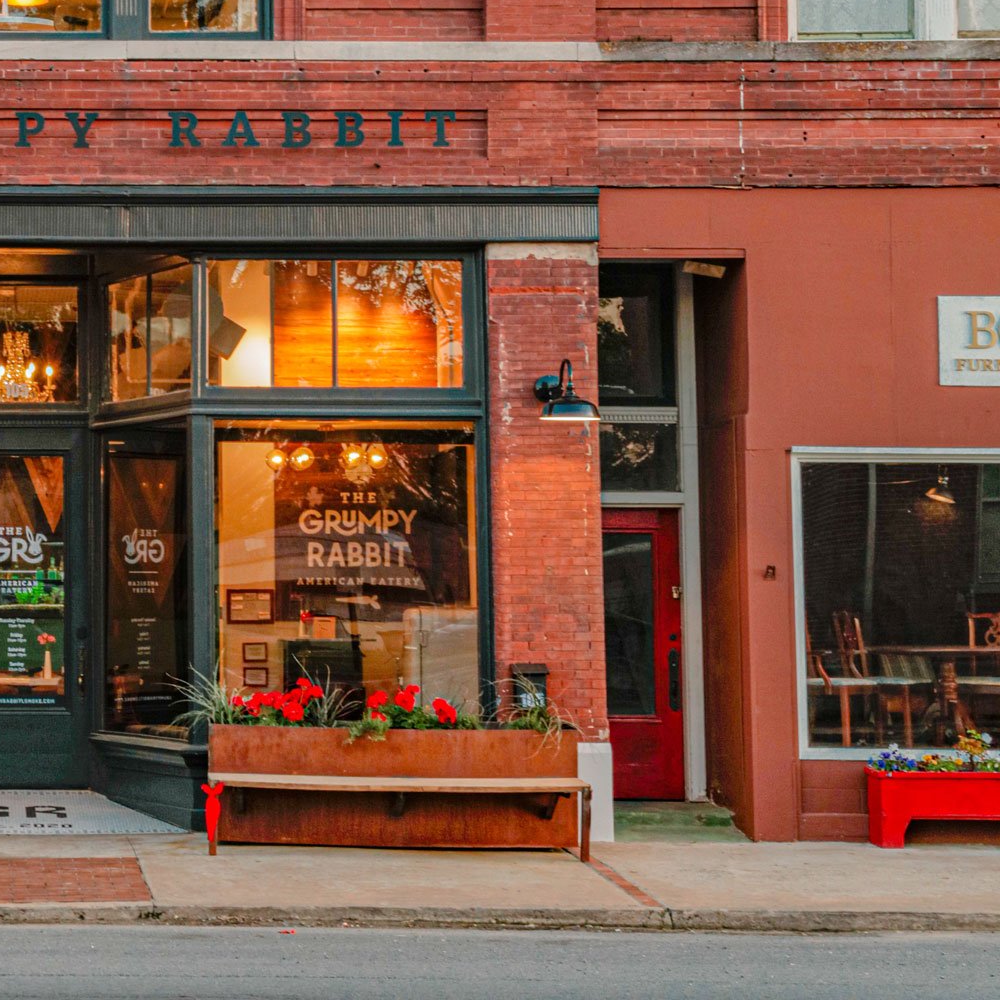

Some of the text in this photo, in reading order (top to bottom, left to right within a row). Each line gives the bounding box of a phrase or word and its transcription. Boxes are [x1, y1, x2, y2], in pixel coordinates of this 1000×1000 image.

[168, 110, 456, 148] RABBIT
[966, 310, 1000, 349] B
[340, 492, 377, 504] THE
[298, 509, 418, 536] GRUMPY
[307, 541, 409, 568] RABBIT
[296, 577, 420, 586] AMERICAN EATERY
